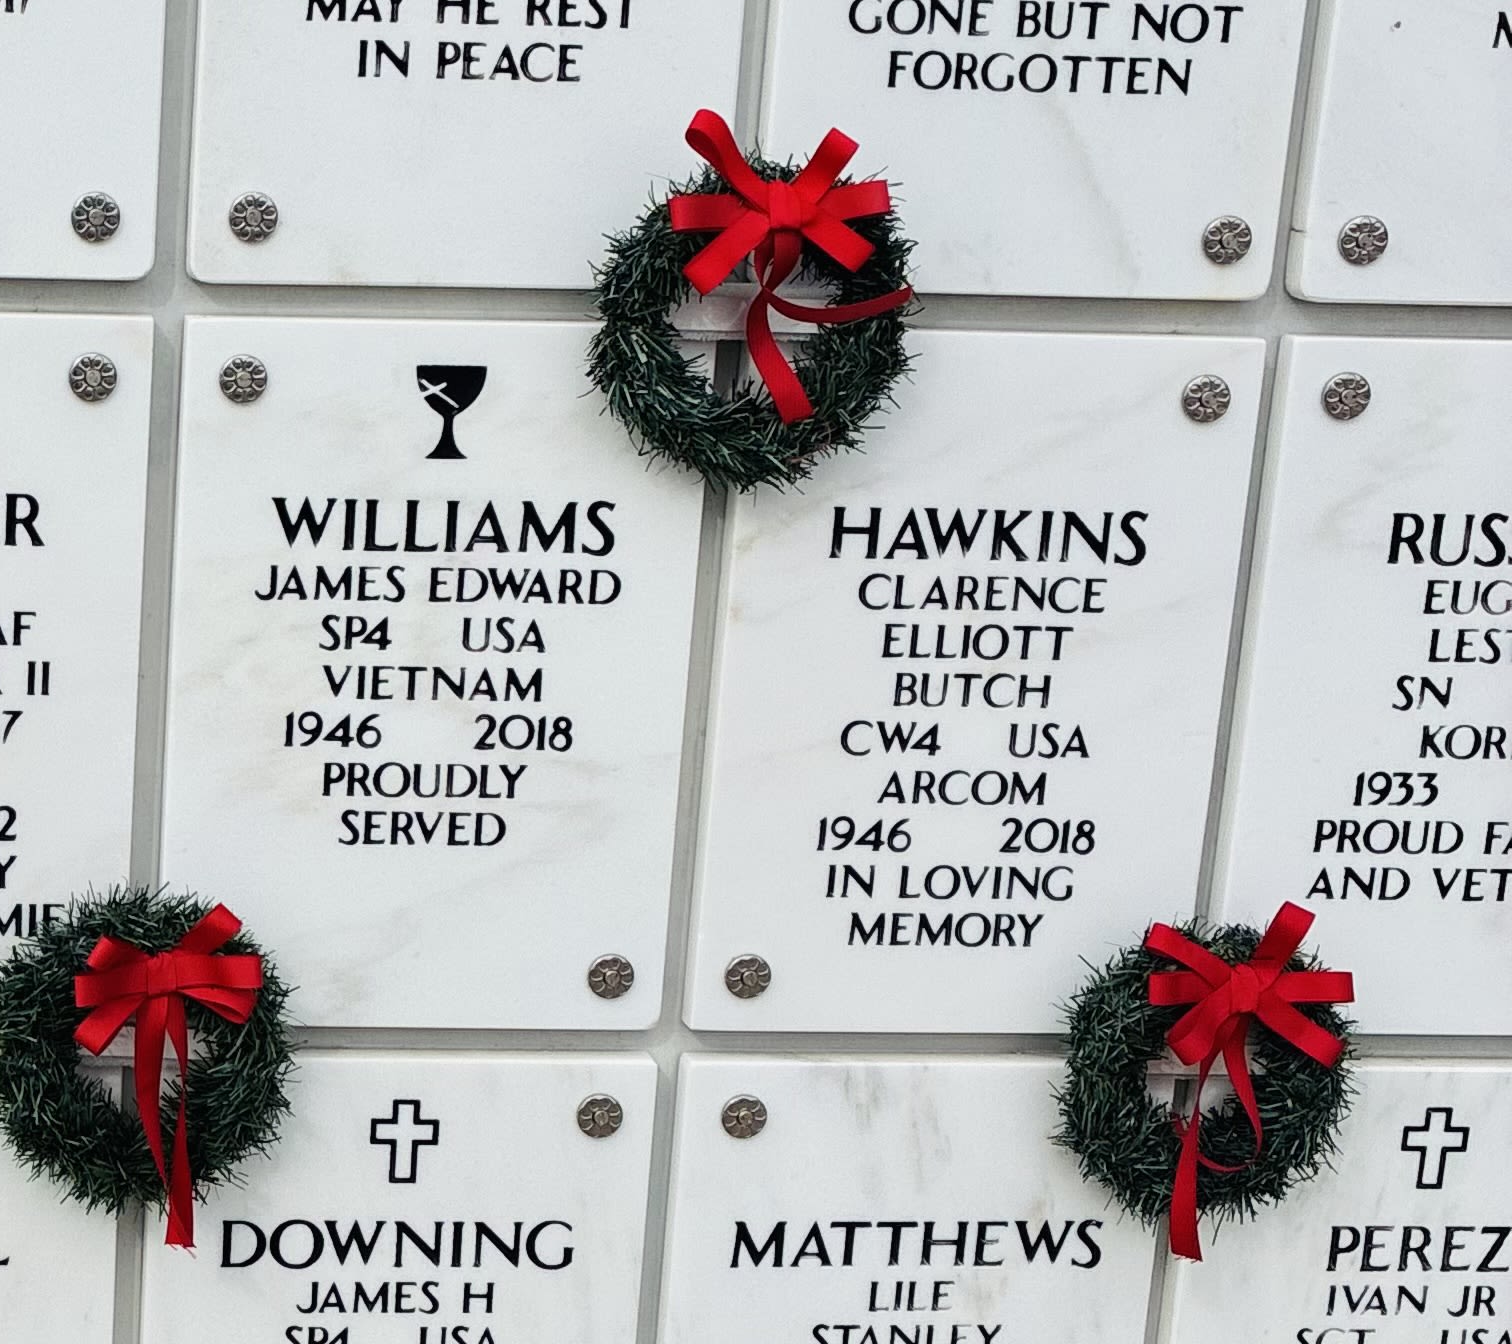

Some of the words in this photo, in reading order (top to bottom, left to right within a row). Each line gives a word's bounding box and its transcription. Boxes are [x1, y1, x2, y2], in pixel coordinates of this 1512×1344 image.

[1015, 0, 1111, 41] BUT
[1130, 2, 1245, 45] NOT
[886, 49, 1194, 97] FORGOTTEN
[270, 495, 617, 558] WILLIAMS
[828, 505, 1150, 568] HAWKINS
[253, 564, 407, 604] JAMES
[427, 566, 623, 606] EDWARD
[880, 622, 1075, 662] ELLIOTT
[25, 660, 51, 697] II
[1391, 674, 1454, 712] SN
[283, 710, 383, 750] 1946
[472, 712, 574, 753] 2018
[839, 719, 942, 757] CW4
[1007, 721, 1091, 760] USA
[321, 761, 529, 800] PROUDLY
[1352, 770, 1440, 808] 1933
[824, 863, 876, 899] IN
[897, 863, 1074, 903] LOVING
[219, 1218, 575, 1271] DOWNING
[729, 1218, 1104, 1270] MATTHEWS
[1325, 1284, 1430, 1317] IVAN
[1446, 1284, 1497, 1318] JR
